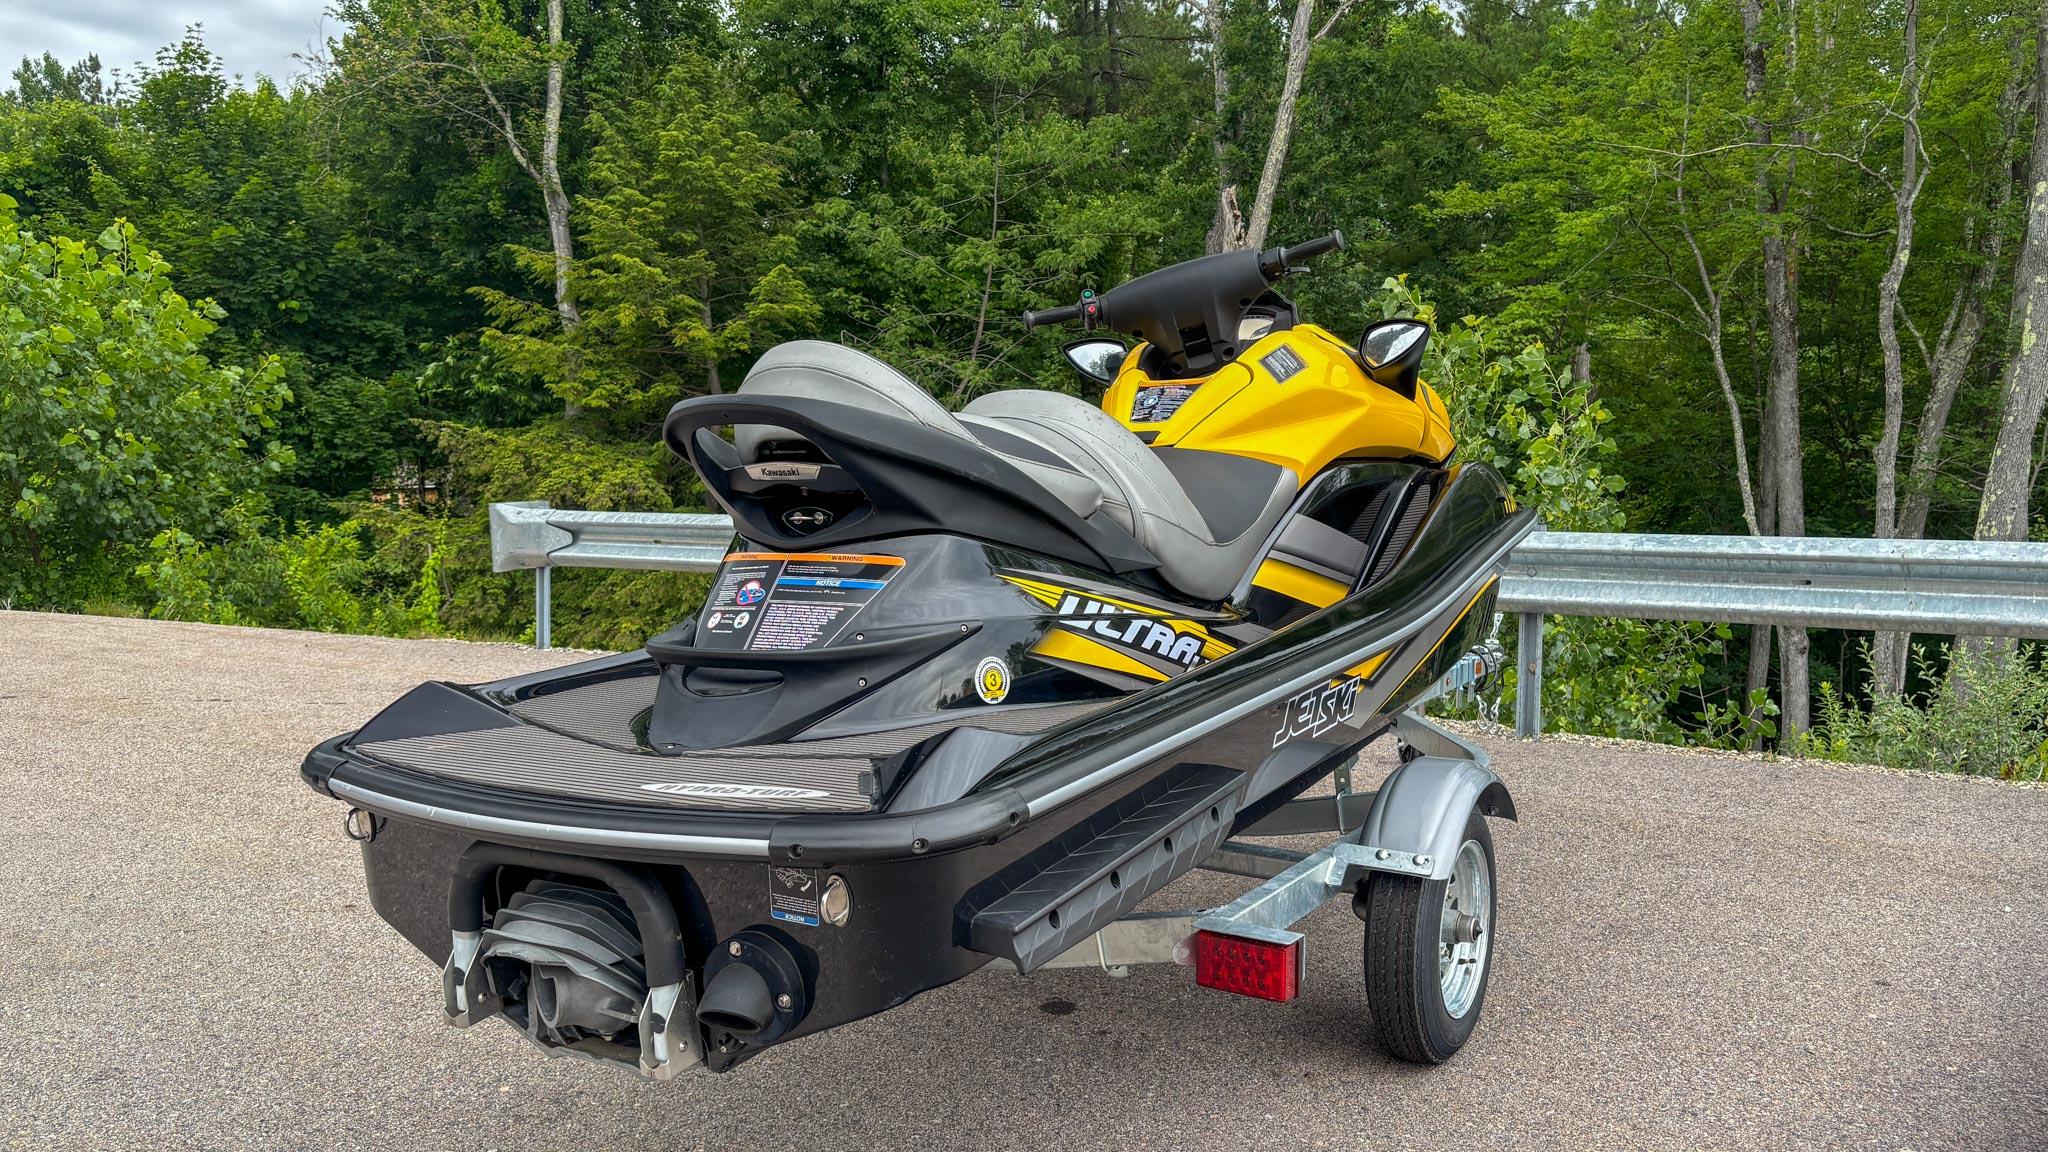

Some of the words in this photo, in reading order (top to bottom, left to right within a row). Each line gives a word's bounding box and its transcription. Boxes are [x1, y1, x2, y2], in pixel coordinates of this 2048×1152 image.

[761, 467, 801, 477] Kawasaki
[831, 555, 864, 563] WARNING
[815, 579, 842, 587] NOTICE
[1058, 594, 1202, 665] ULTRA
[989, 673, 997, 687] 3
[657, 784, 811, 797] HYDRO-TURF
[784, 913, 805, 923] NOTICE
